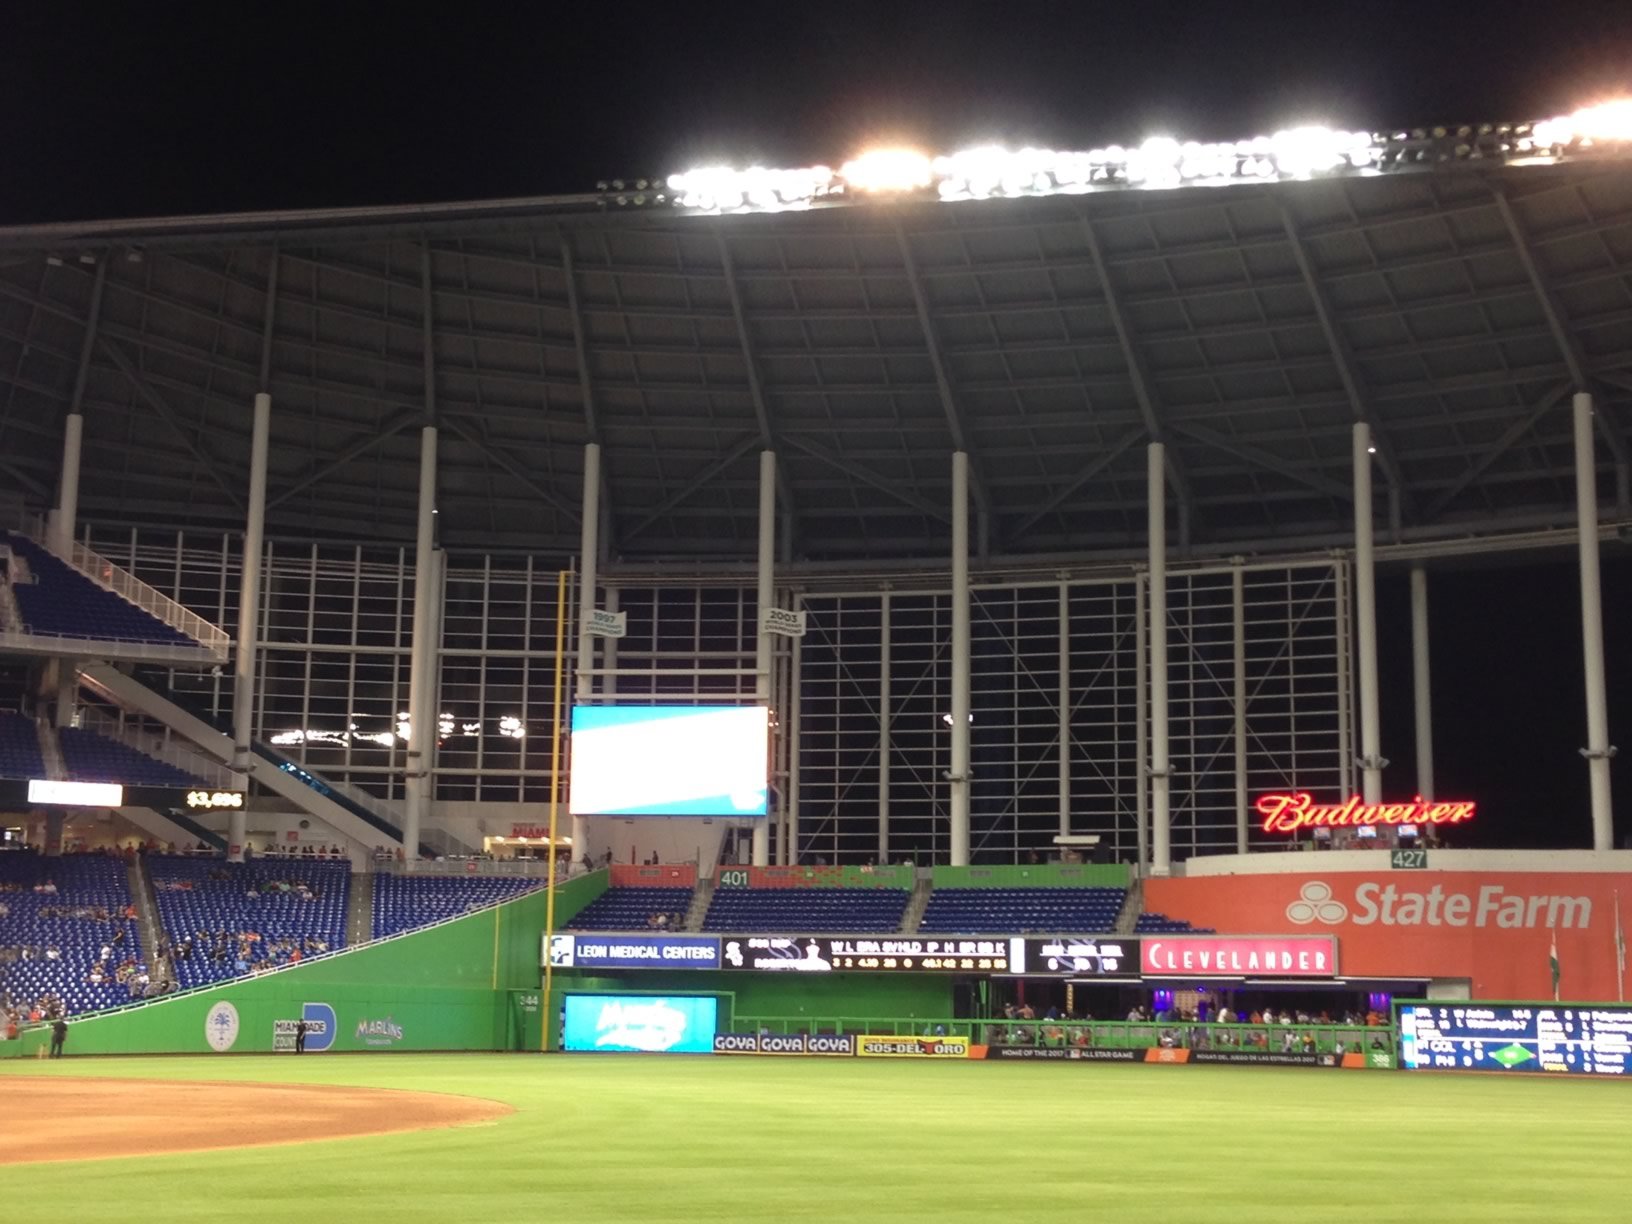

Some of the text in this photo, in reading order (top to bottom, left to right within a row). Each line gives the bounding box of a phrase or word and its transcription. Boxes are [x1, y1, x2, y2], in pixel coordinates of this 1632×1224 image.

[770, 610, 798, 623] 2003
[1257, 793, 1475, 832] Budweiser
[1393, 852, 1425, 867] 427
[721, 872, 747, 885] 401
[1352, 882, 1592, 928] State Farm
[577, 945, 608, 958] LEON
[610, 945, 661, 959] MEDICAL
[662, 946, 716, 960] CENTERS
[1149, 943, 1326, 970] CLEVELANDER
[520, 996, 538, 1005] 344
[355, 1018, 403, 1040] MARLINS
[275, 1037, 297, 1047] COUNT
[715, 1036, 756, 1050] GOYA
[761, 1038, 802, 1051] GOYA
[808, 1038, 850, 1052] GOYA
[1002, 1049, 1022, 1057] HOME
[1024, 1049, 1033, 1057] OF
[1034, 1049, 1048, 1057] THE
[1048, 1049, 1064, 1057] 2017
